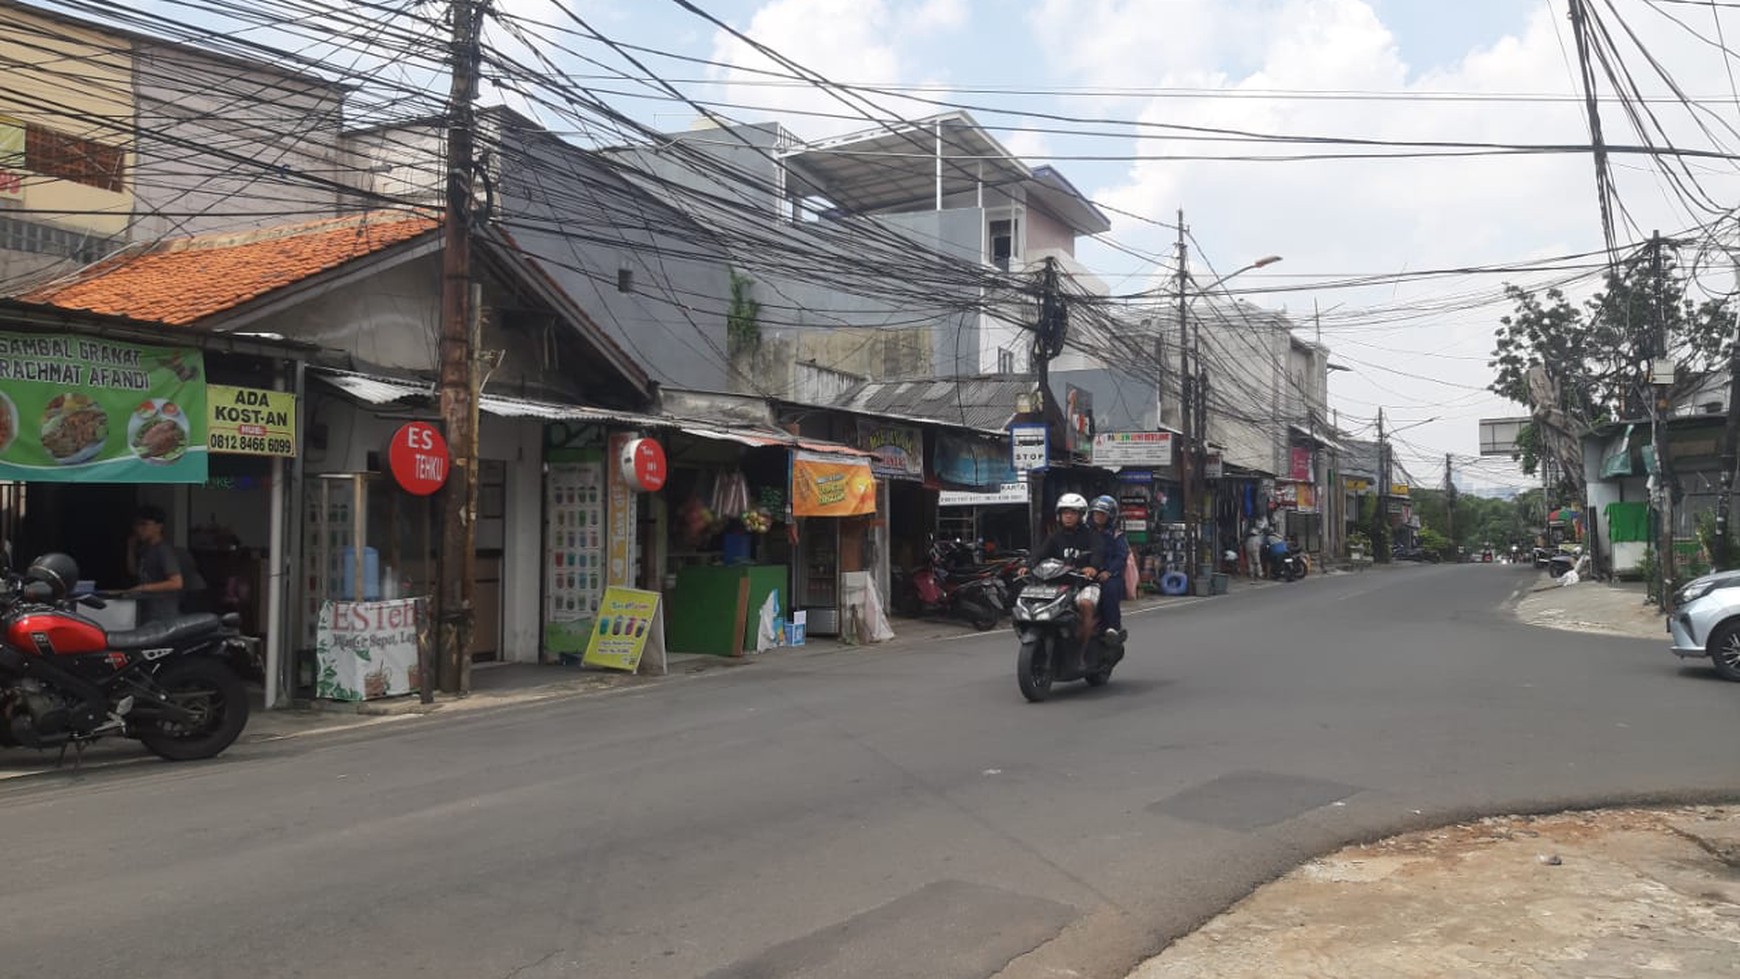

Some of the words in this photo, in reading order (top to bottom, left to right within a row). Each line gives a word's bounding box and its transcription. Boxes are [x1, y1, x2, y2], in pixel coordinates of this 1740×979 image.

[0, 338, 73, 358] SAMBAL
[78, 341, 142, 366] GRANAT
[0, 360, 82, 385] RACHMAT
[88, 367, 150, 391] AFANDI
[234, 390, 270, 407] ADA
[215, 405, 288, 426] KOST-AN
[210, 434, 237, 449] 0812
[239, 436, 265, 451] 8466
[268, 438, 292, 453] 6099
[408, 426, 433, 450] ES
[415, 453, 443, 481] TEHKU
[1015, 453, 1044, 461] STOP
